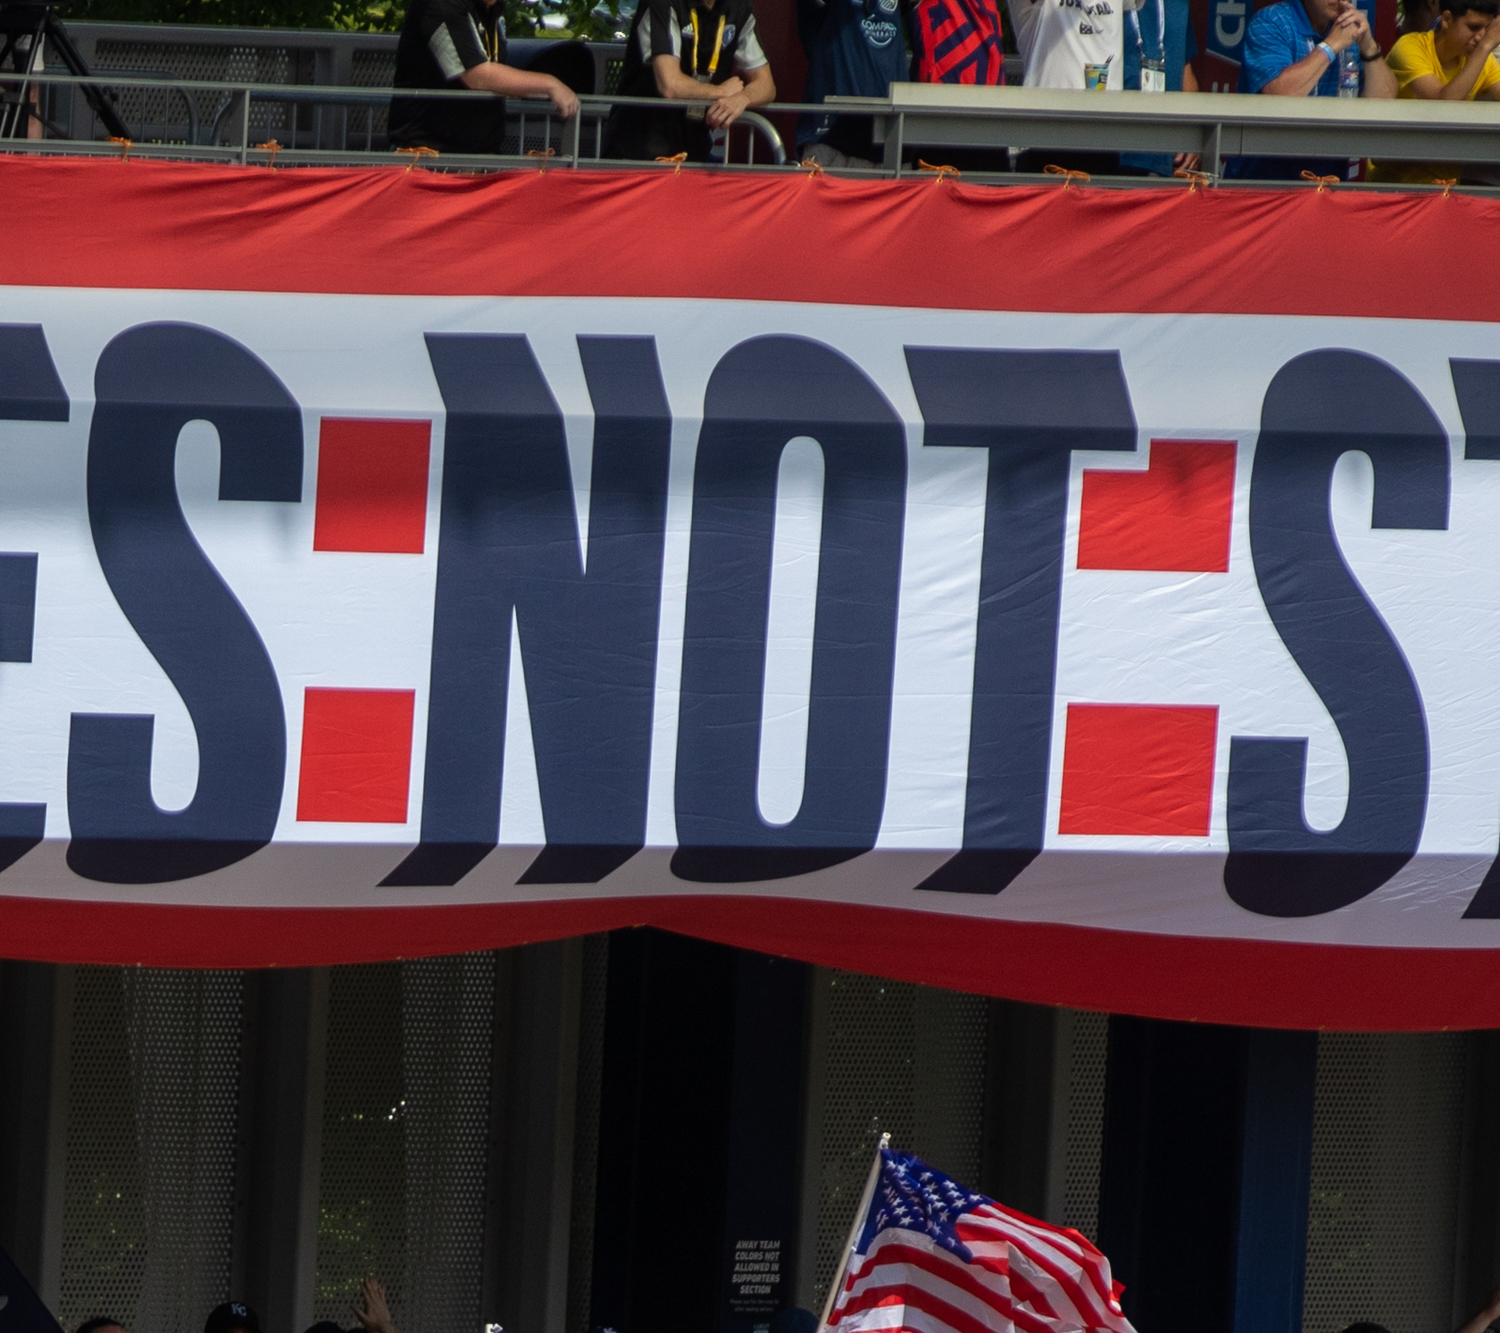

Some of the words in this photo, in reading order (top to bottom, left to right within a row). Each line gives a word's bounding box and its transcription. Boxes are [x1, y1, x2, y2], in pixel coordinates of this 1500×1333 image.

[377, 330, 1138, 894] NOT
[735, 1241, 756, 1250] AWAY
[758, 1241, 780, 1250] TEAM
[734, 1252, 765, 1261] COLORS
[767, 1252, 781, 1261] NOT
[734, 1263, 768, 1273] ALLOWED
[770, 1263, 780, 1273] IN
[731, 1274, 781, 1284] SUPPORTERS
[740, 1285, 771, 1295] SECTION
